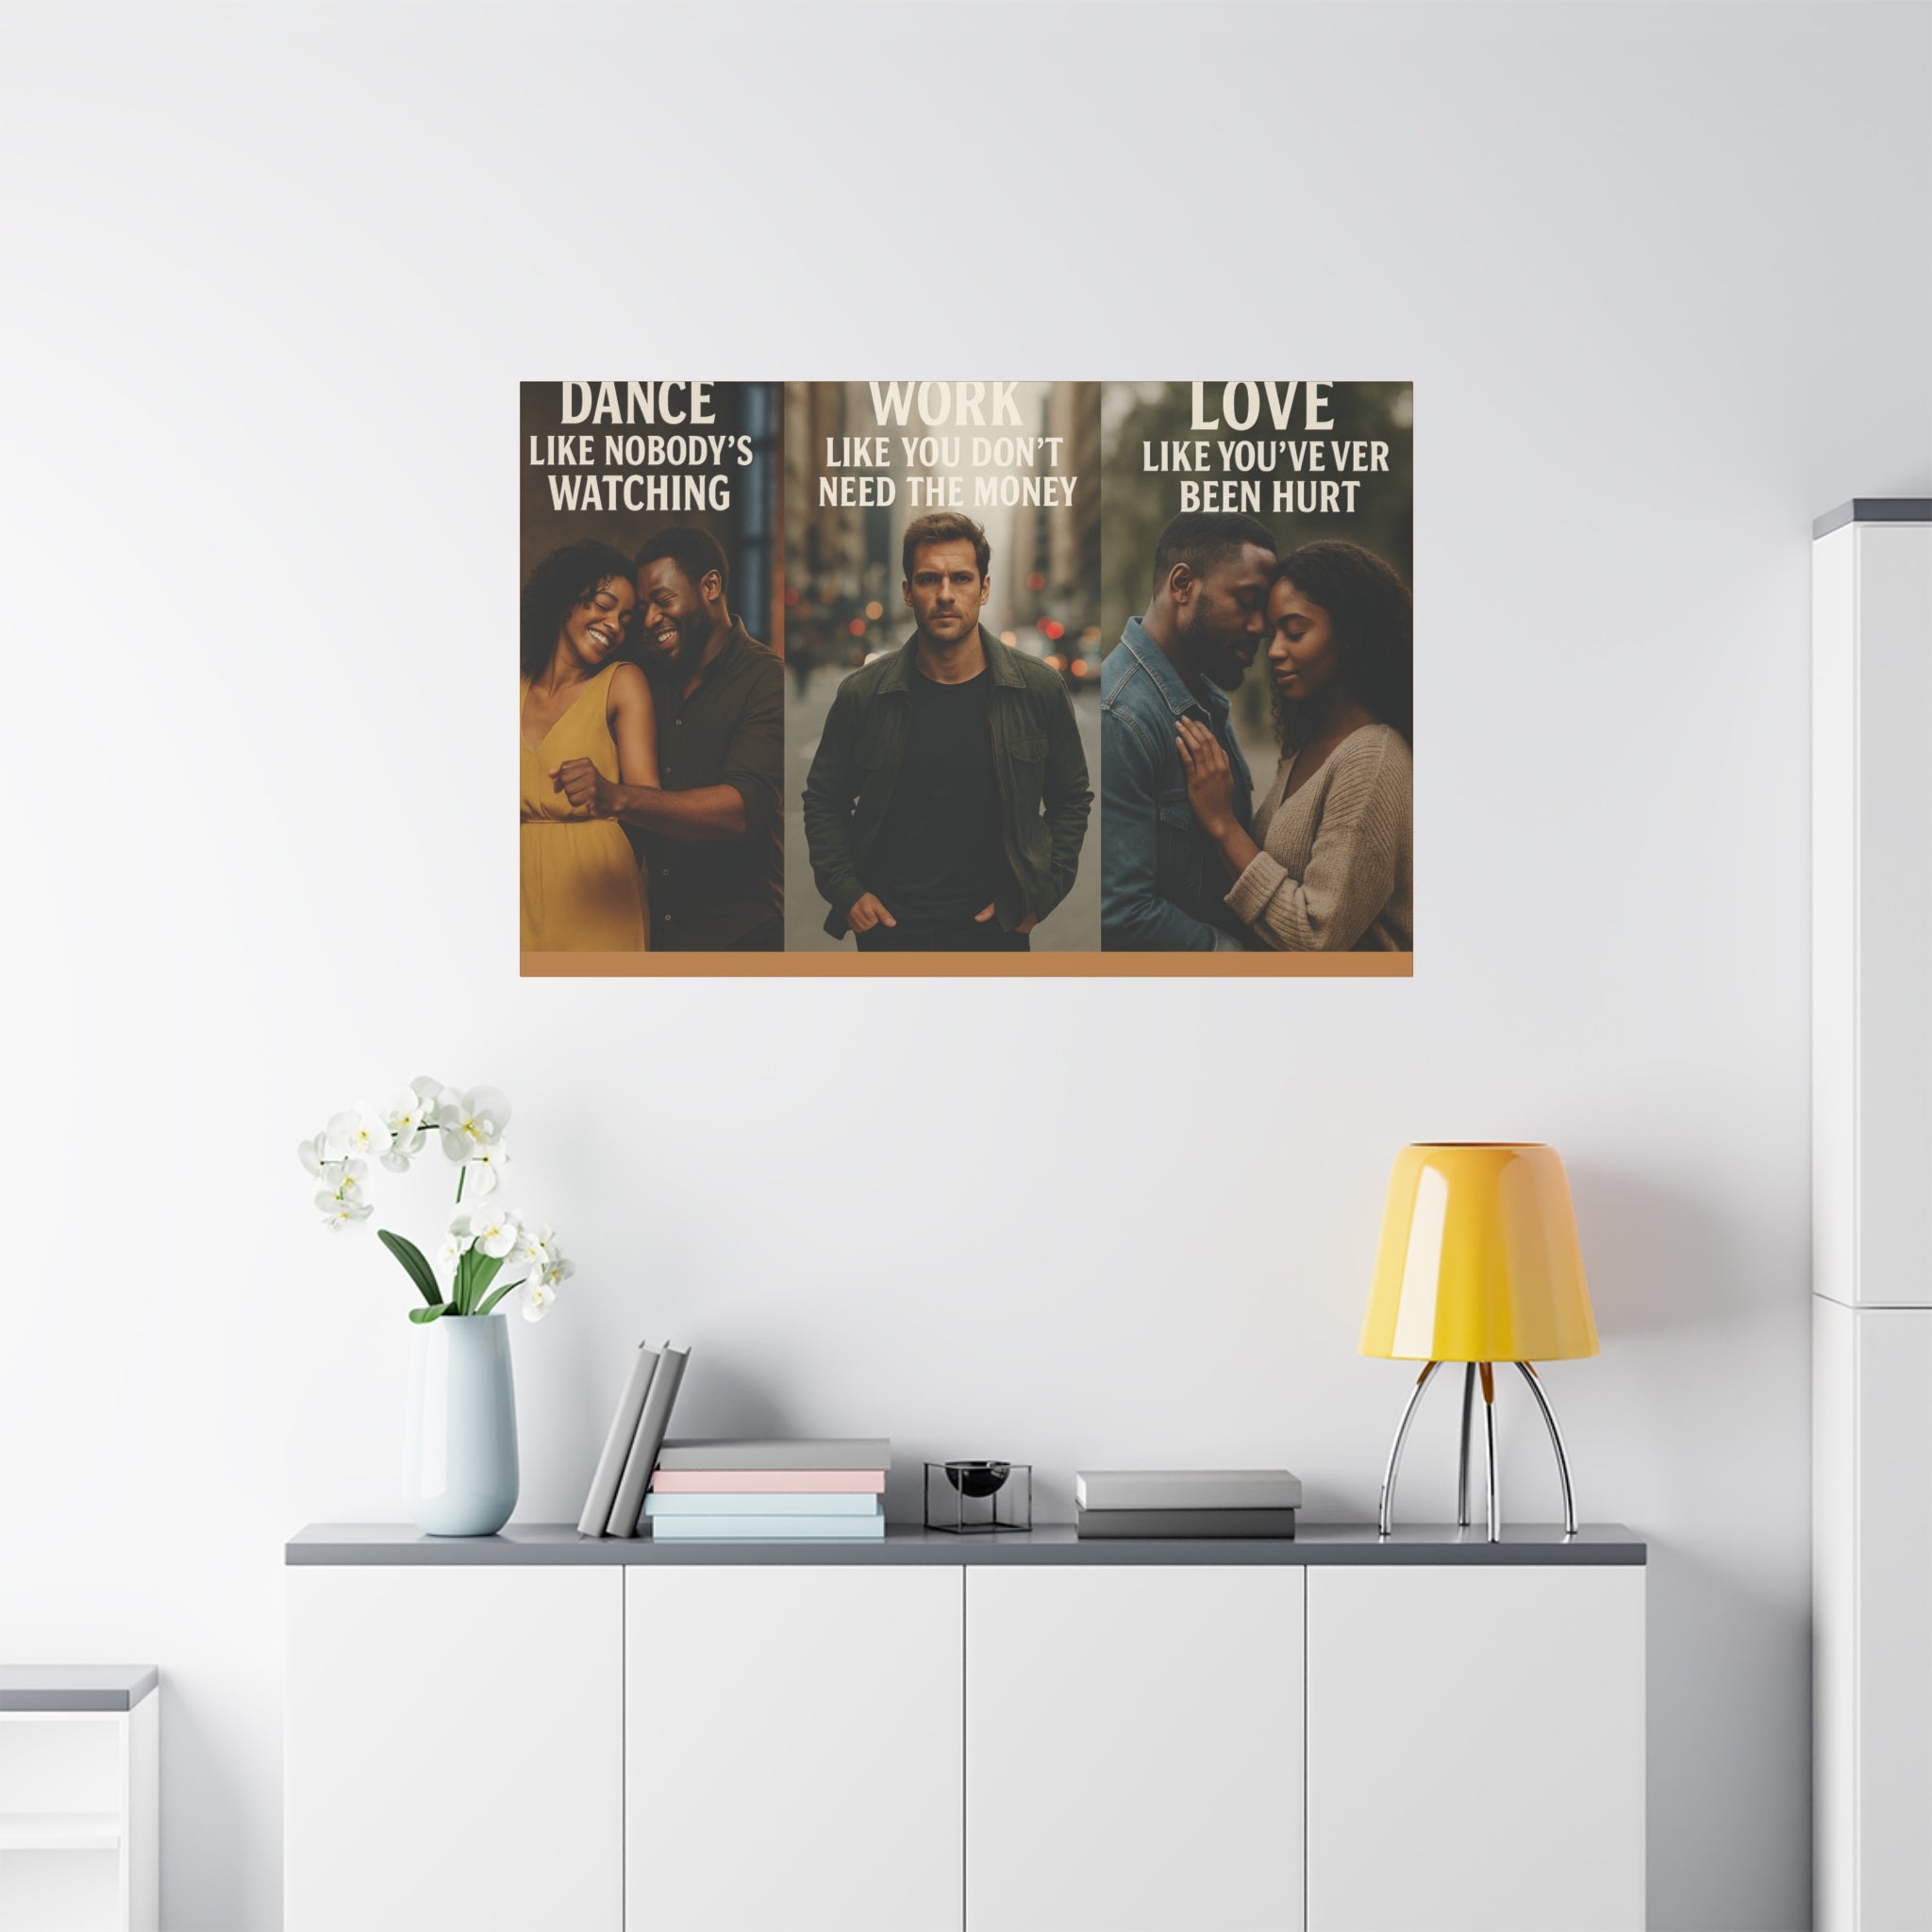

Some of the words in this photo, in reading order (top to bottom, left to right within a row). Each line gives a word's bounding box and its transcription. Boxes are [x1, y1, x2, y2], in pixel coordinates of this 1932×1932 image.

[561, 381, 716, 425] DANCE
[869, 381, 1024, 426] WORK
[1190, 381, 1335, 431] LOVE
[529, 435, 595, 466] LIKE
[605, 435, 754, 466] NOBODY’S
[825, 437, 891, 467] LIKE
[903, 437, 960, 467] YOU
[971, 437, 1063, 467] DON’T
[1142, 440, 1210, 473] LIKE
[1217, 440, 1324, 473] YOU’VE
[1331, 440, 1390, 473] VER
[547, 474, 731, 511] WATCHING
[819, 475, 896, 507] NEED
[906, 475, 963, 507] THE
[974, 475, 1078, 508] MONEY
[1179, 480, 1261, 513] BEEN
[1273, 480, 1361, 513] HURT
